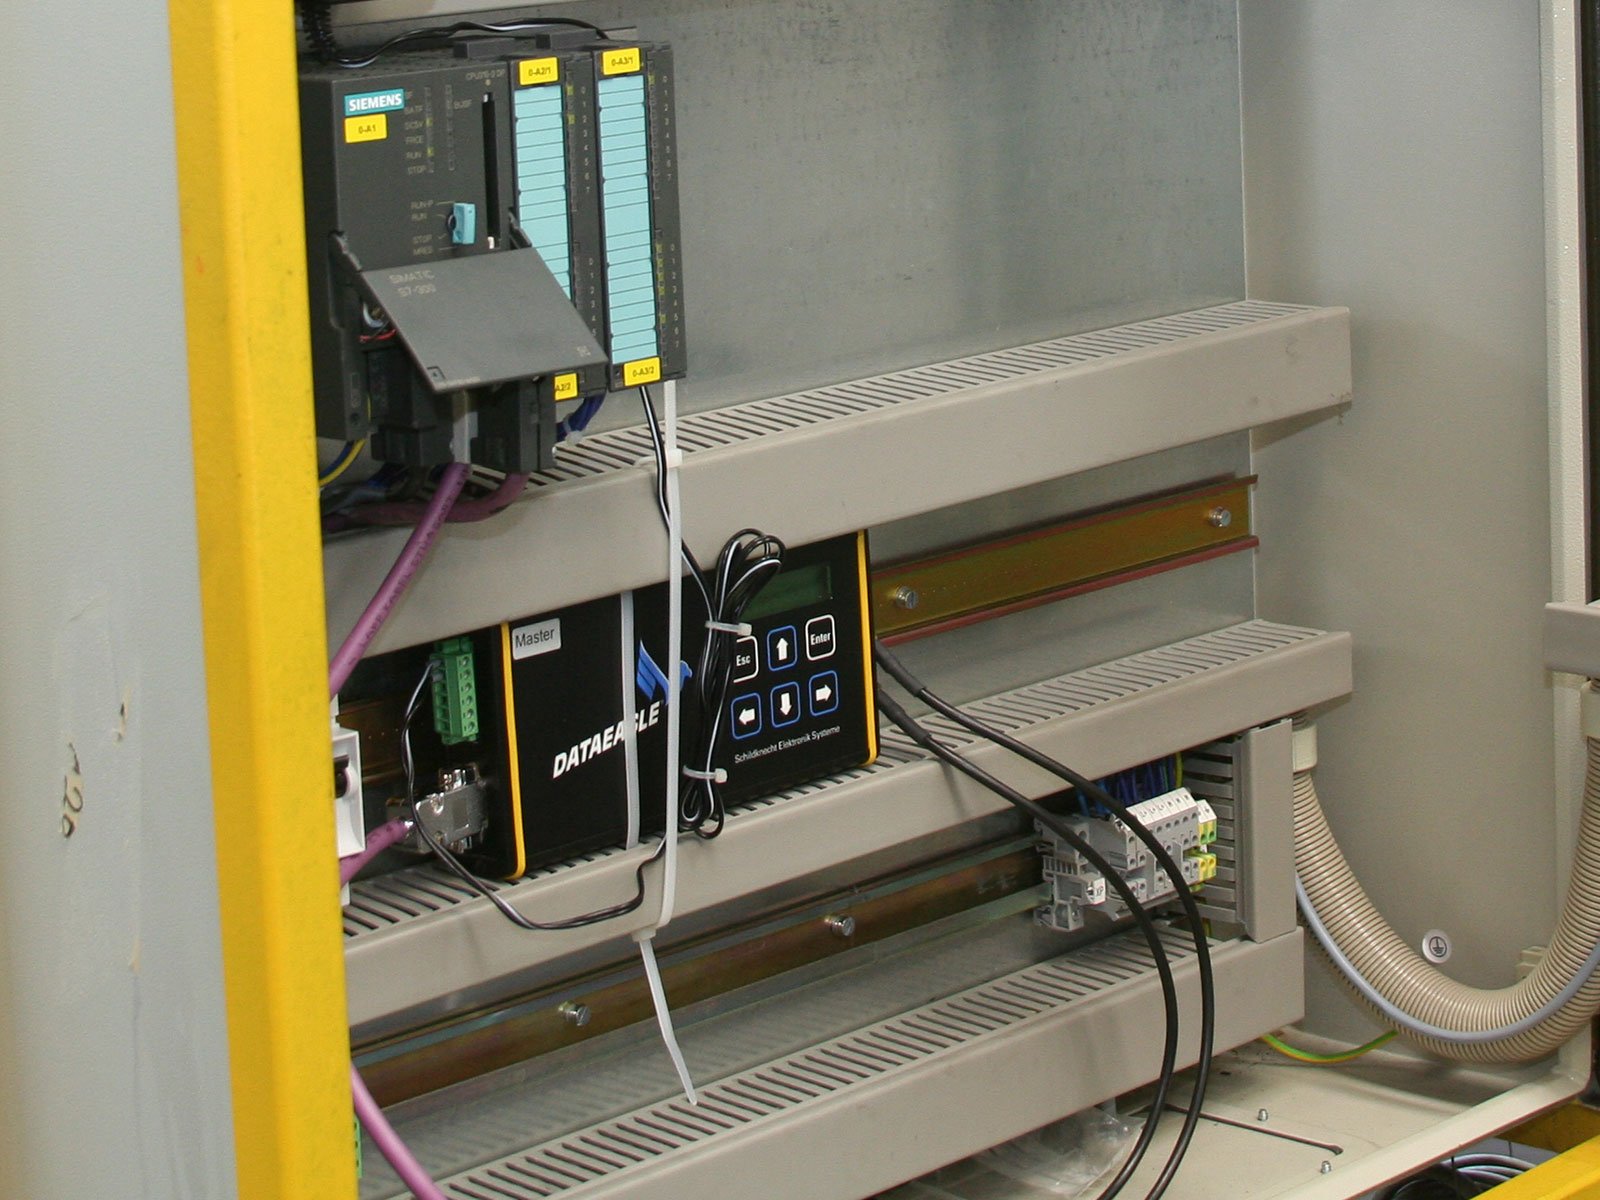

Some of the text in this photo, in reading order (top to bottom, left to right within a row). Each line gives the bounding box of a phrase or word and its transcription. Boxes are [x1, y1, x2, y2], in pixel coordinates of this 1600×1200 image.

[611, 56, 633, 66] 0-A3/1
[528, 66, 551, 76] 0-A2/1
[348, 93, 403, 112] SIEMENS
[358, 124, 377, 135] 0-A1
[632, 366, 655, 377] 0-A3/2
[514, 627, 555, 649] Master
[810, 632, 831, 646] Enter
[736, 654, 751, 667] Esc
[734, 725, 841, 764] Schildknecht Elektronik Systeme
